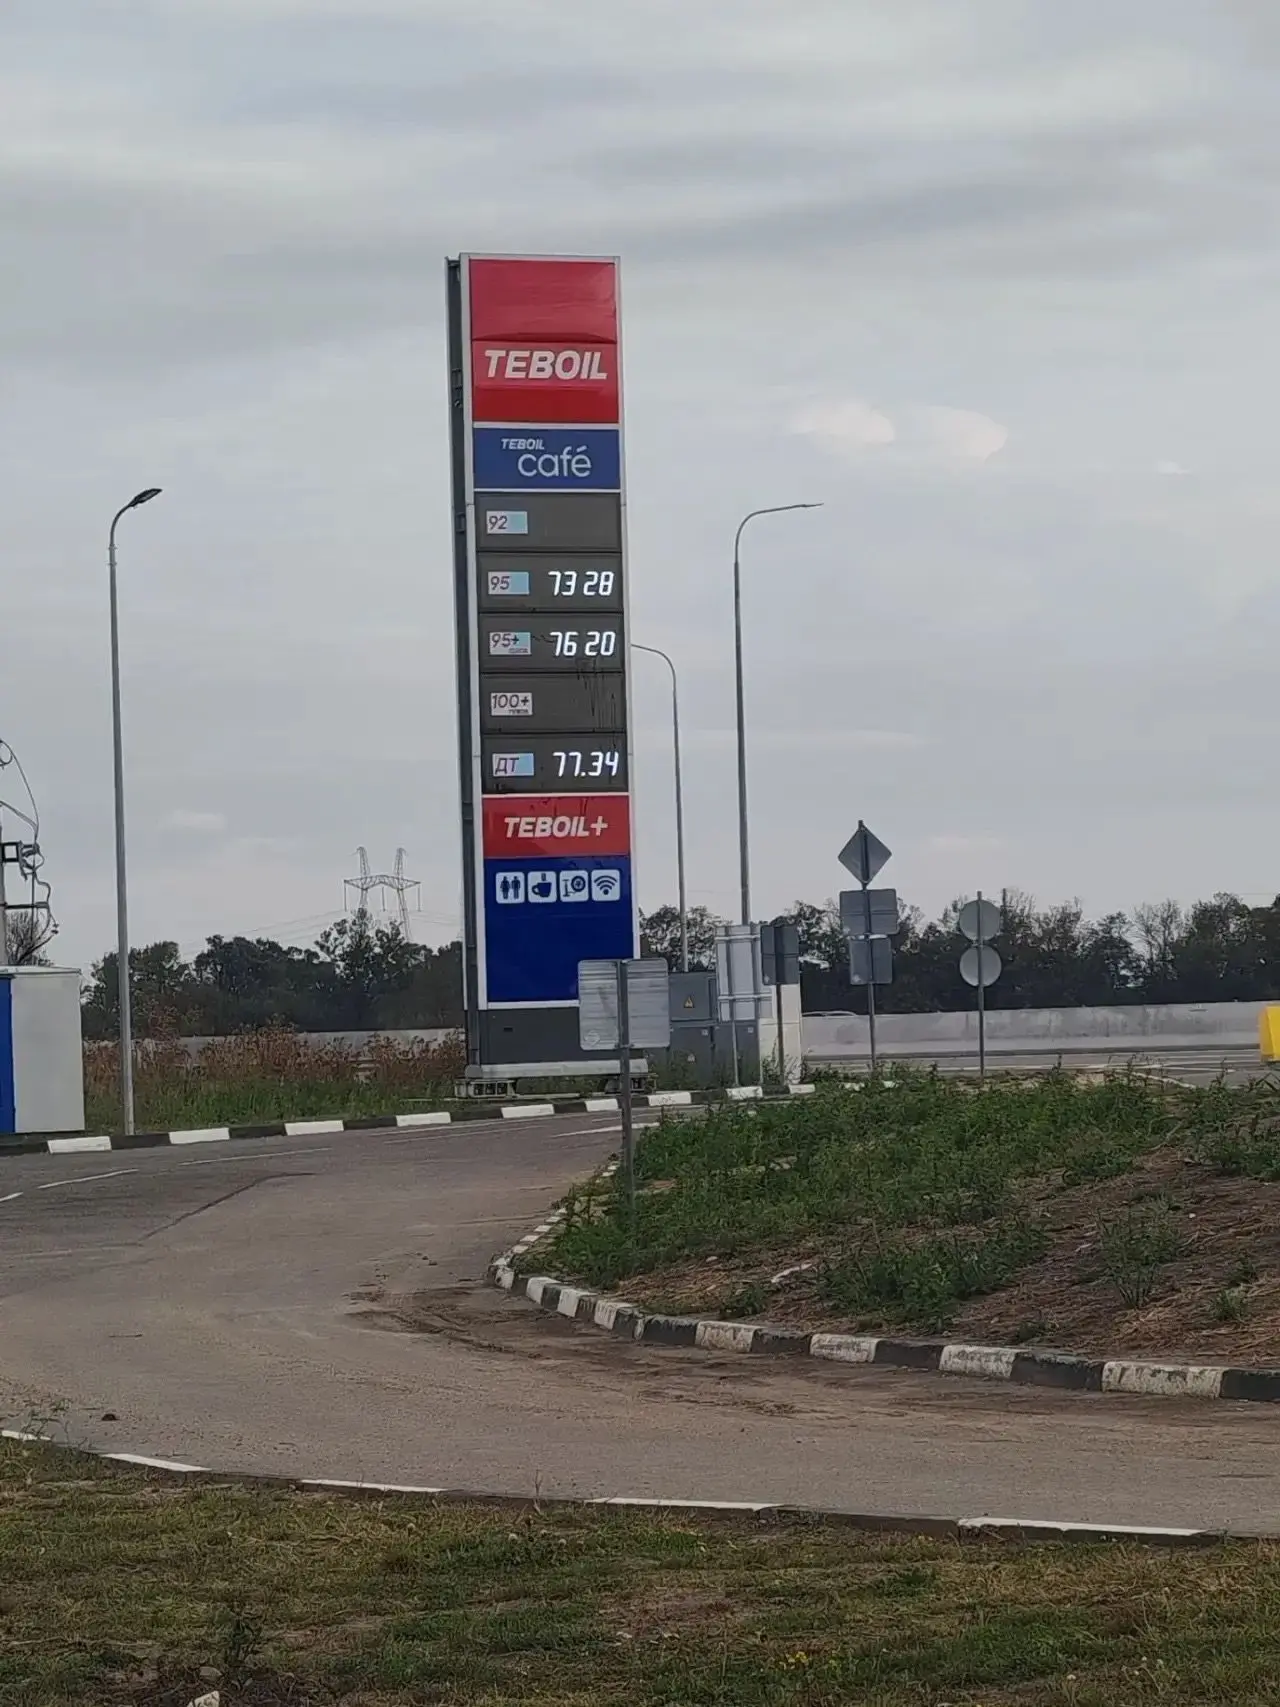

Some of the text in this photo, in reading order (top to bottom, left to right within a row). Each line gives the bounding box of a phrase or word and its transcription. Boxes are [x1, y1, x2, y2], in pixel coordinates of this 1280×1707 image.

[485, 349, 608, 380] TEBOIL
[501, 438, 545, 450] TEBOIL
[518, 445, 592, 477] café
[489, 515, 508, 530] 92
[490, 576, 510, 591] 95
[491, 633, 520, 648] 95+
[492, 694, 529, 709] 100+
[495, 757, 520, 775] ДТ
[552, 751, 619, 777] 77.34
[504, 815, 609, 838] TEBOIL+
